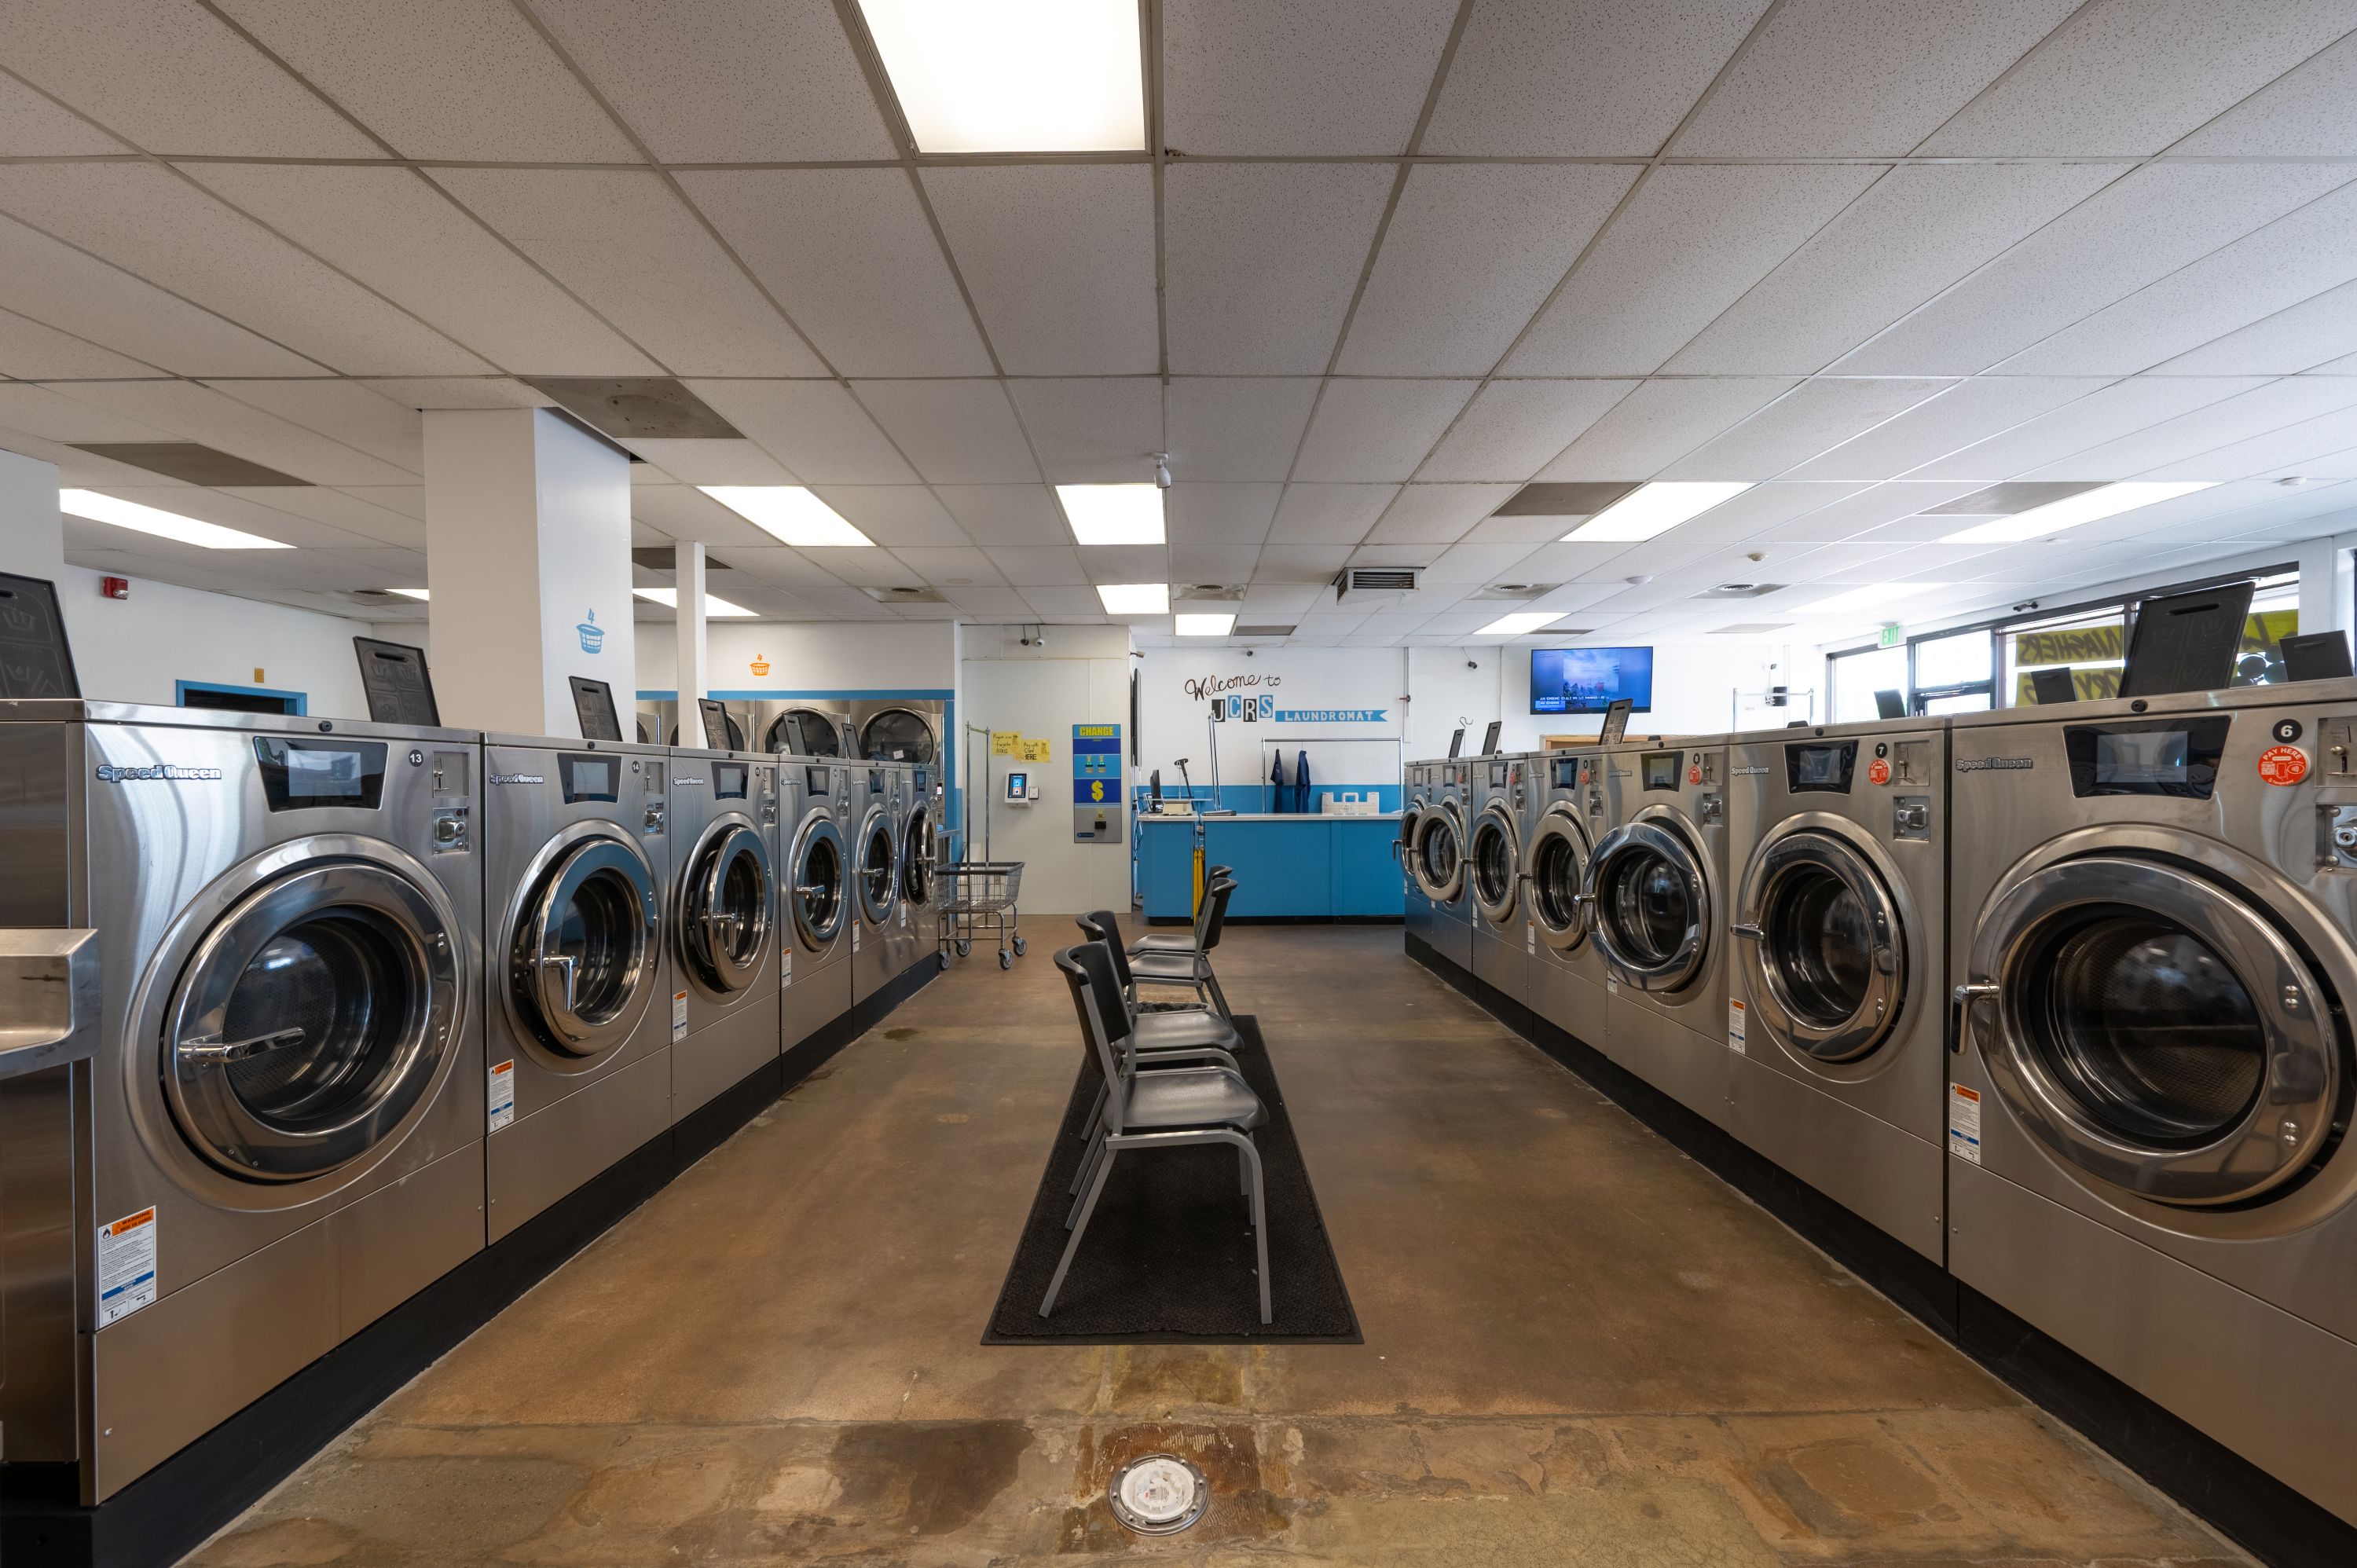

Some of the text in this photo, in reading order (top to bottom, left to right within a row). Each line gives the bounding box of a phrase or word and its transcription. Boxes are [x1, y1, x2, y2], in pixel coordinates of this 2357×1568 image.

[1882, 626, 1899, 646] EXIT
[1185, 674, 1281, 701] Welcome to
[1213, 695, 1273, 722] JCRS
[1285, 711, 1373, 721] LAUNDROMAT
[1080, 727, 1114, 736] CHANGE
[2280, 725, 2293, 737] 6
[1879, 746, 1884, 755] 7
[2263, 747, 2302, 760] PAY HERE
[410, 754, 422, 763] 13
[1956, 757, 2033, 772] Speed Queen
[96, 764, 222, 783] Speed Queen
[1731, 766, 1749, 776] Speed
[489, 773, 544, 786] Speed Queen
[673, 777, 689, 786] Speed
[122, 1211, 151, 1225] WARNING
